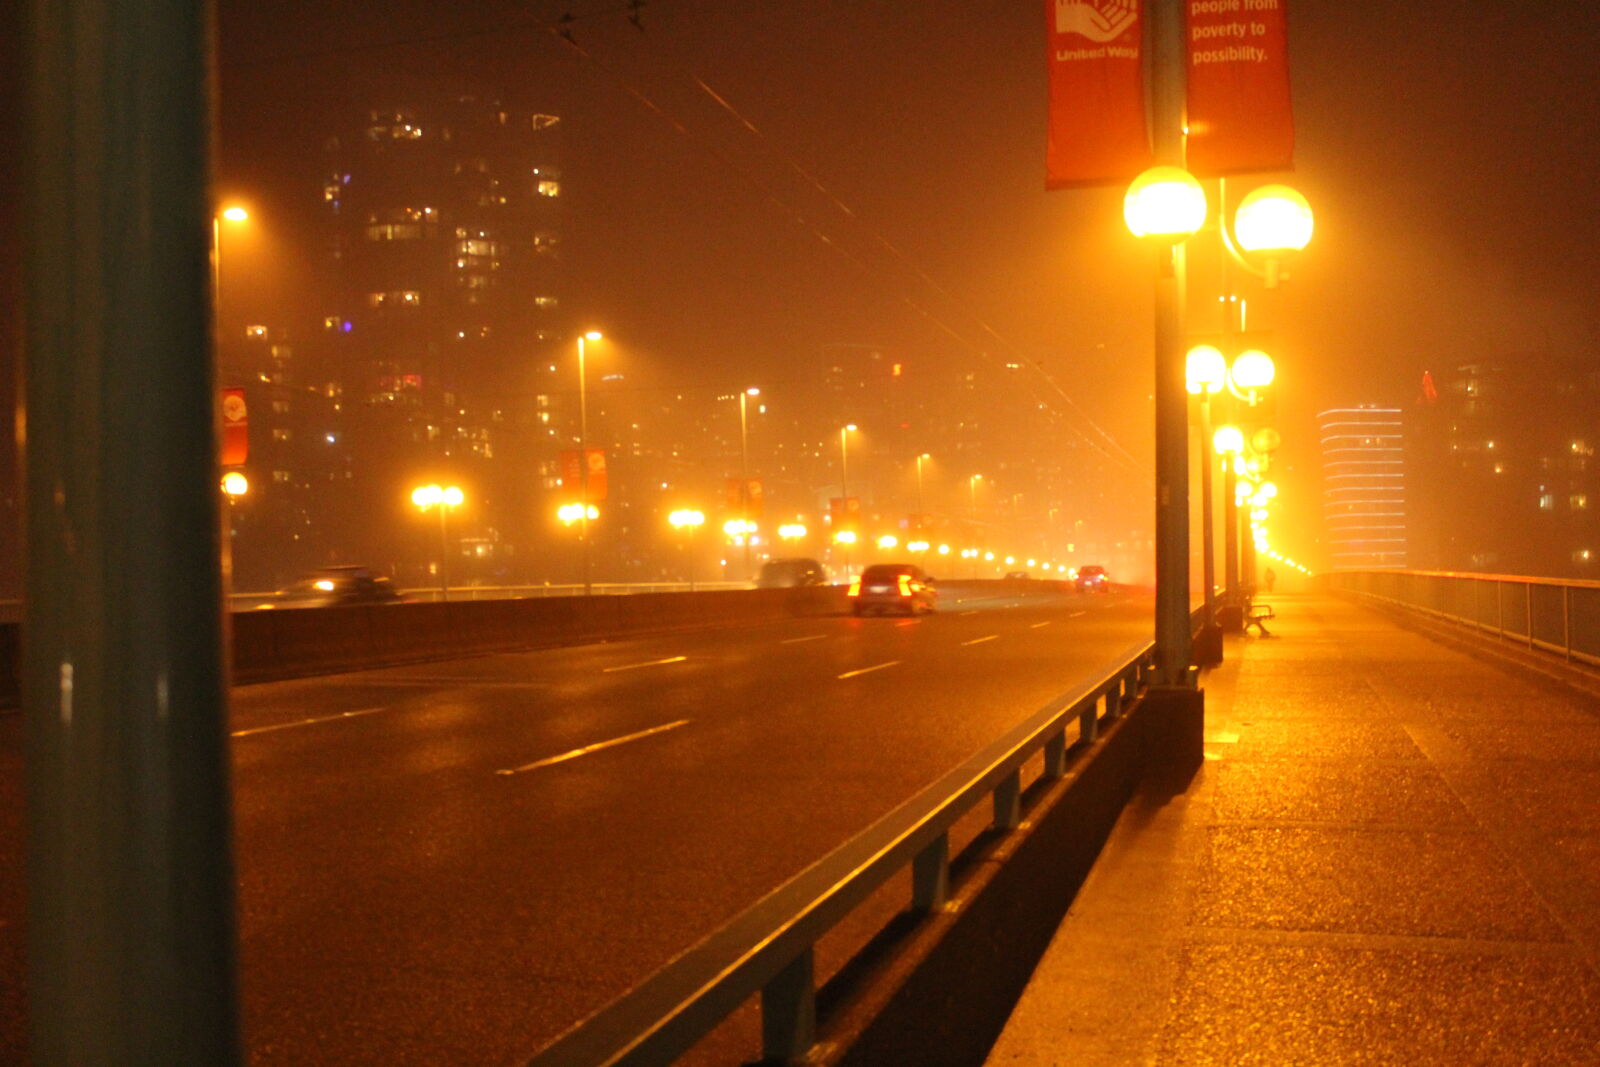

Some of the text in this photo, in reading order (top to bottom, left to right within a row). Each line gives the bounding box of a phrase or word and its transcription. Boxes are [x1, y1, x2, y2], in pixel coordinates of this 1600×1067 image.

[1192, 0, 1278, 16] people from
[1192, 21, 1266, 41] poverty to
[1056, 46, 1138, 61] United Way
[1192, 46, 1269, 66] possibility.
